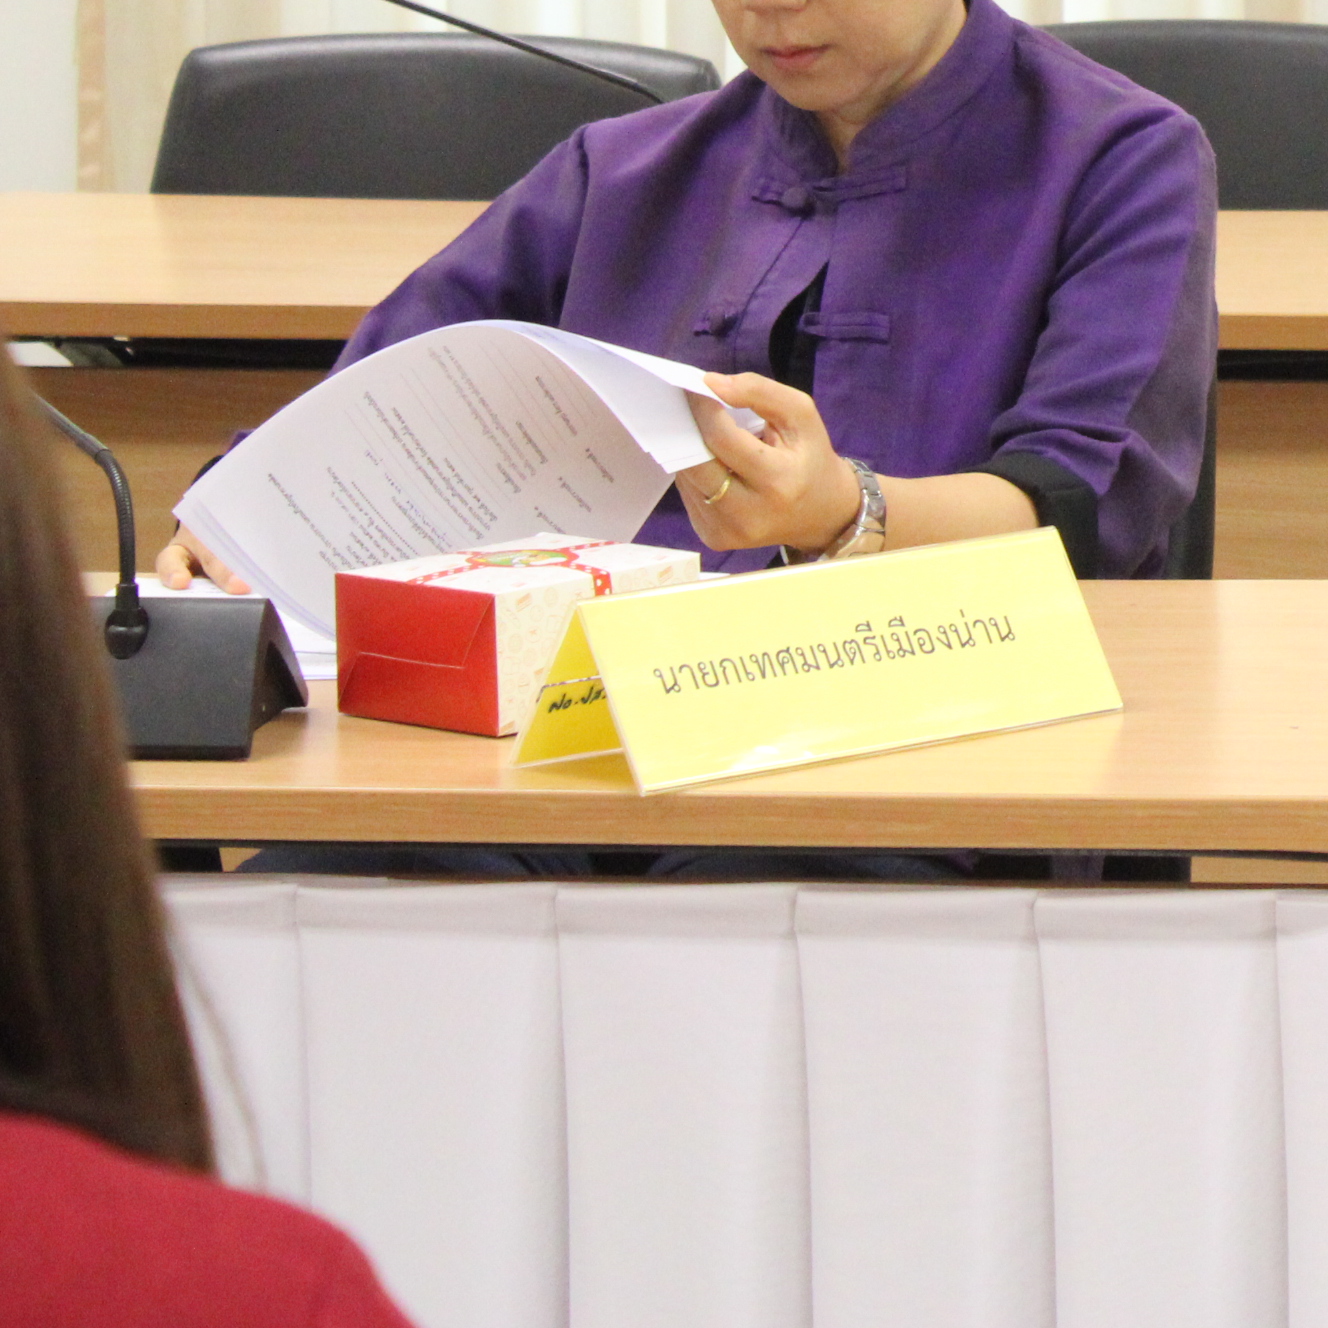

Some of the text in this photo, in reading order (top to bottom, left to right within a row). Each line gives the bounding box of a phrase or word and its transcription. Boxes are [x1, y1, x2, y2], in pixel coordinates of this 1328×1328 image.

[653, 609, 1017, 695] นายกเทศมนตรีเมืองน่าน
